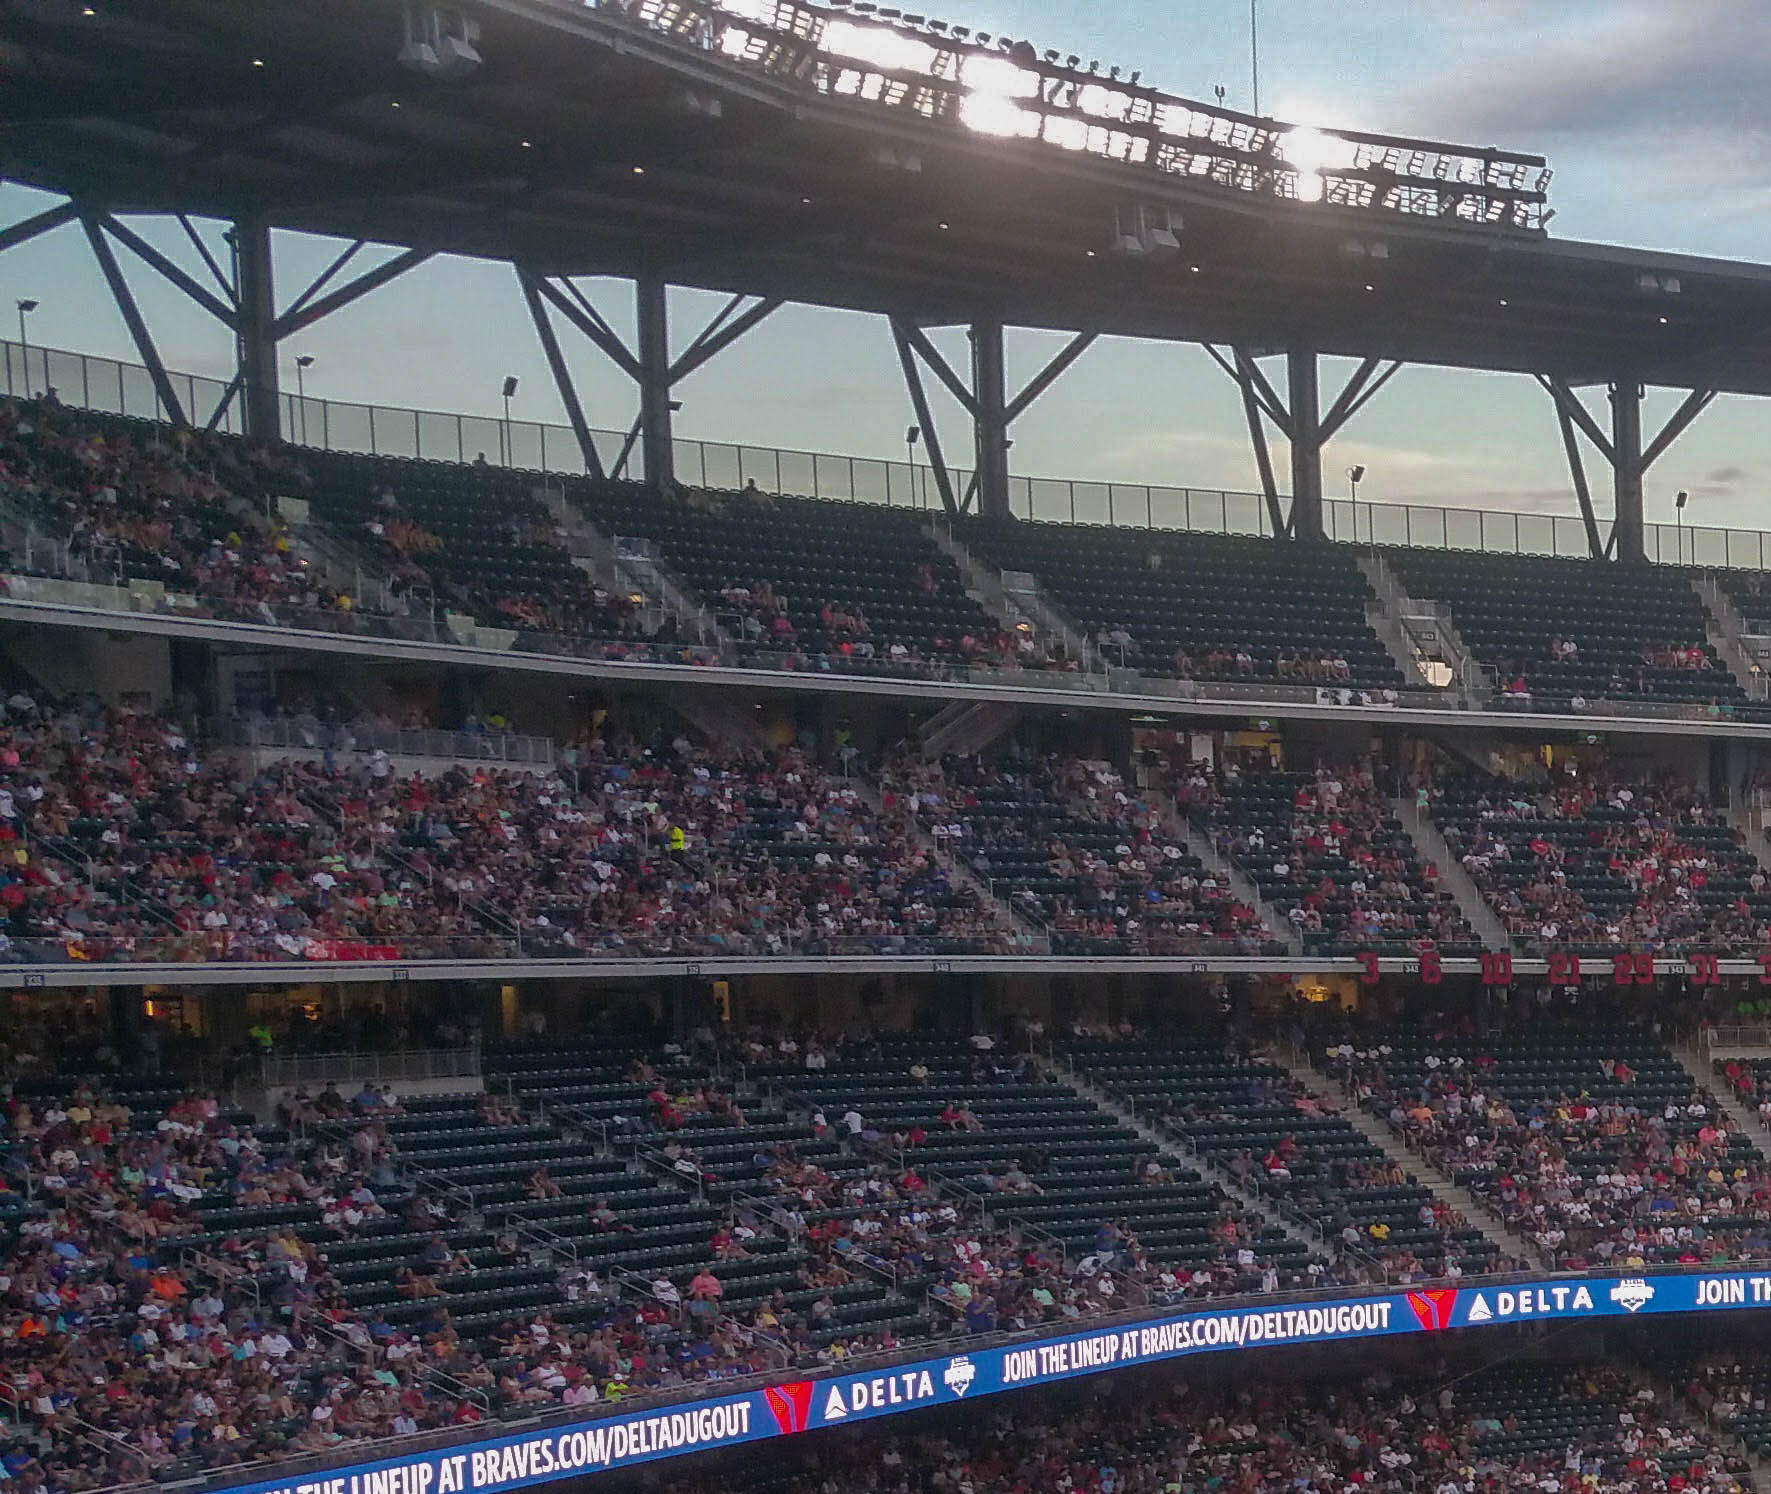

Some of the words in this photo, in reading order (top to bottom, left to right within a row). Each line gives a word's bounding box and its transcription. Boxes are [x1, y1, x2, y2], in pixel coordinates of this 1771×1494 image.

[1498, 1286, 1594, 1315] DELTA
[1696, 1278, 1745, 1306] JOIN
[852, 1371, 934, 1410] DELTA
[438, 1456, 466, 1494] AT
[472, 1401, 751, 1488] BRAVES.COM/DELTADUGOUT
